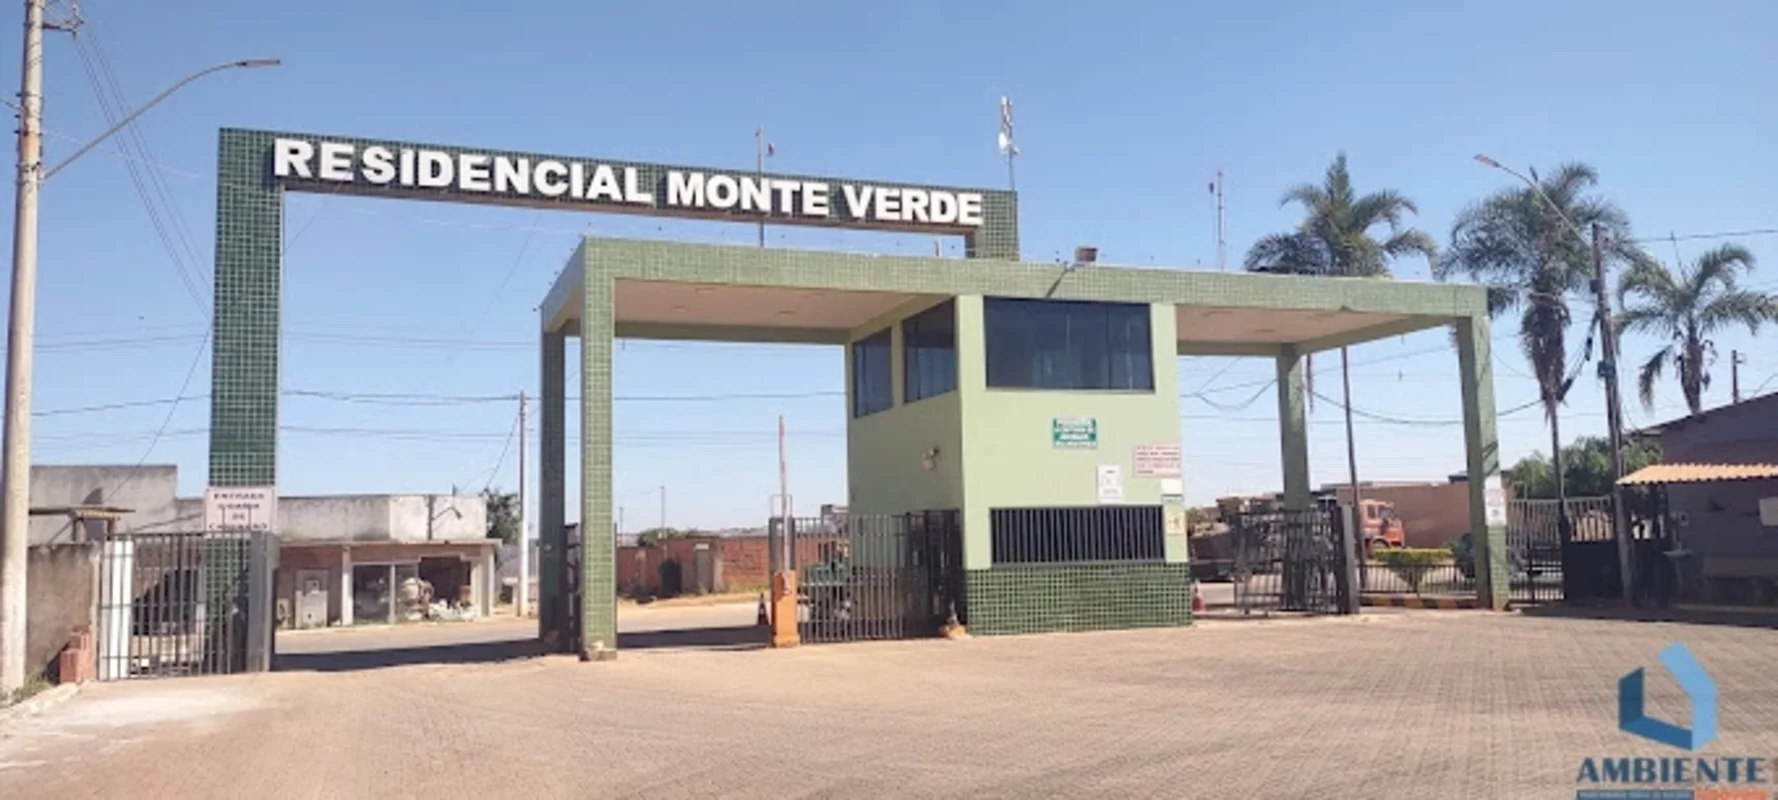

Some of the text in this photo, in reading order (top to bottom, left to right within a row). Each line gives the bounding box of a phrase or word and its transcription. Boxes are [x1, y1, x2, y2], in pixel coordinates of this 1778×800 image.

[273, 138, 985, 226] RESIDENCIAL MONTE VERDE
